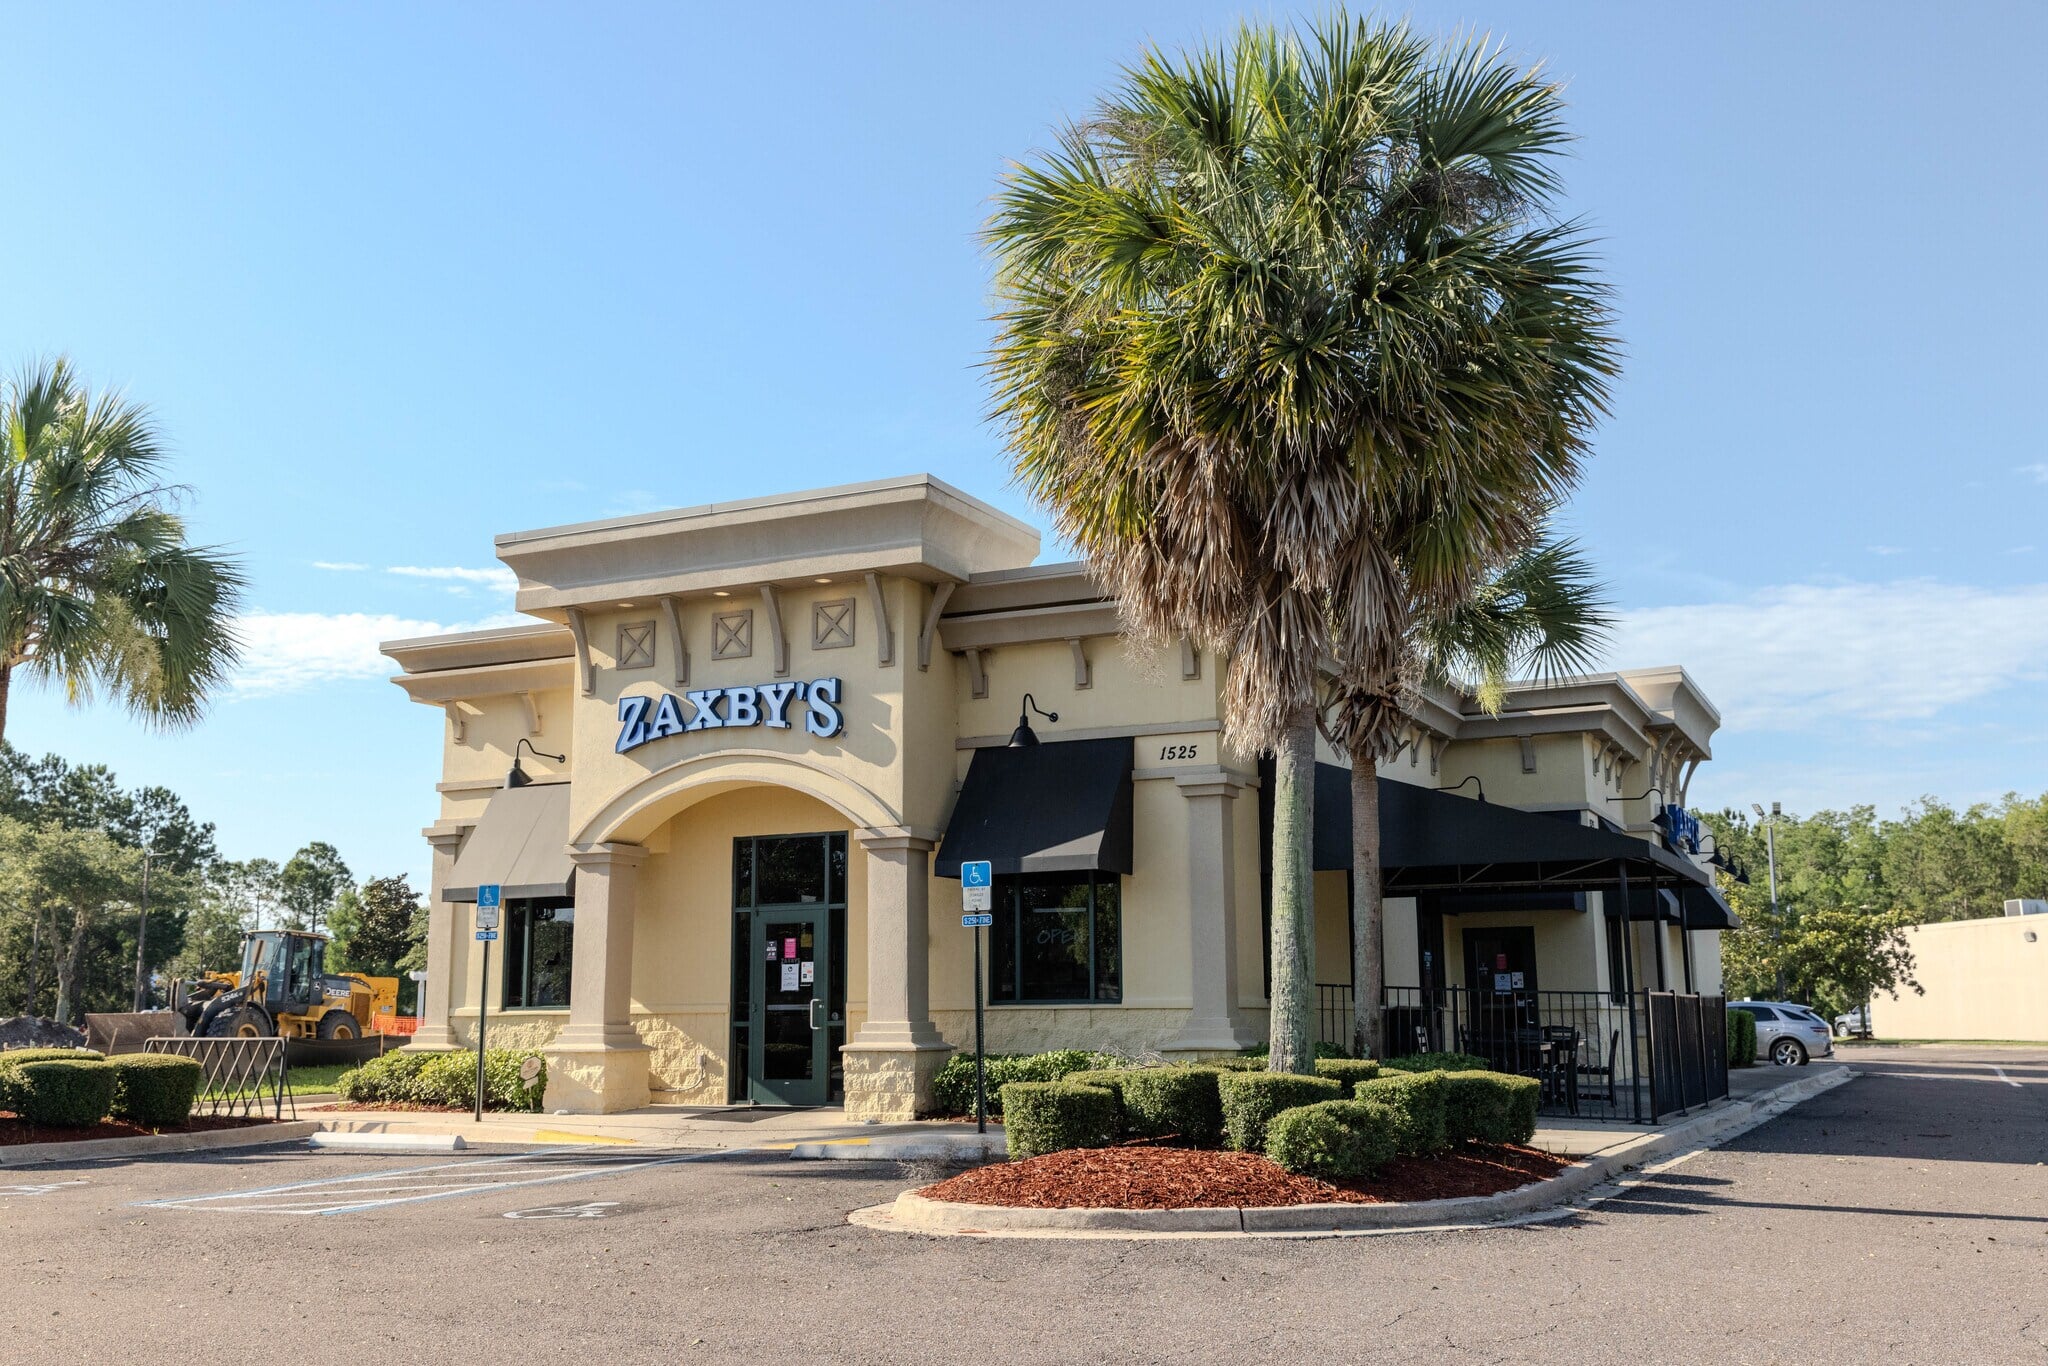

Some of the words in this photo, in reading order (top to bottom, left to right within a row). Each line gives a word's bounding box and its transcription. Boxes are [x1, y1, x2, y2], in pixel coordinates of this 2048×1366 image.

[616, 677, 844, 753] ZAXBY'S
[1160, 745, 1198, 760] 1525
[326, 987, 351, 997] DEERE
